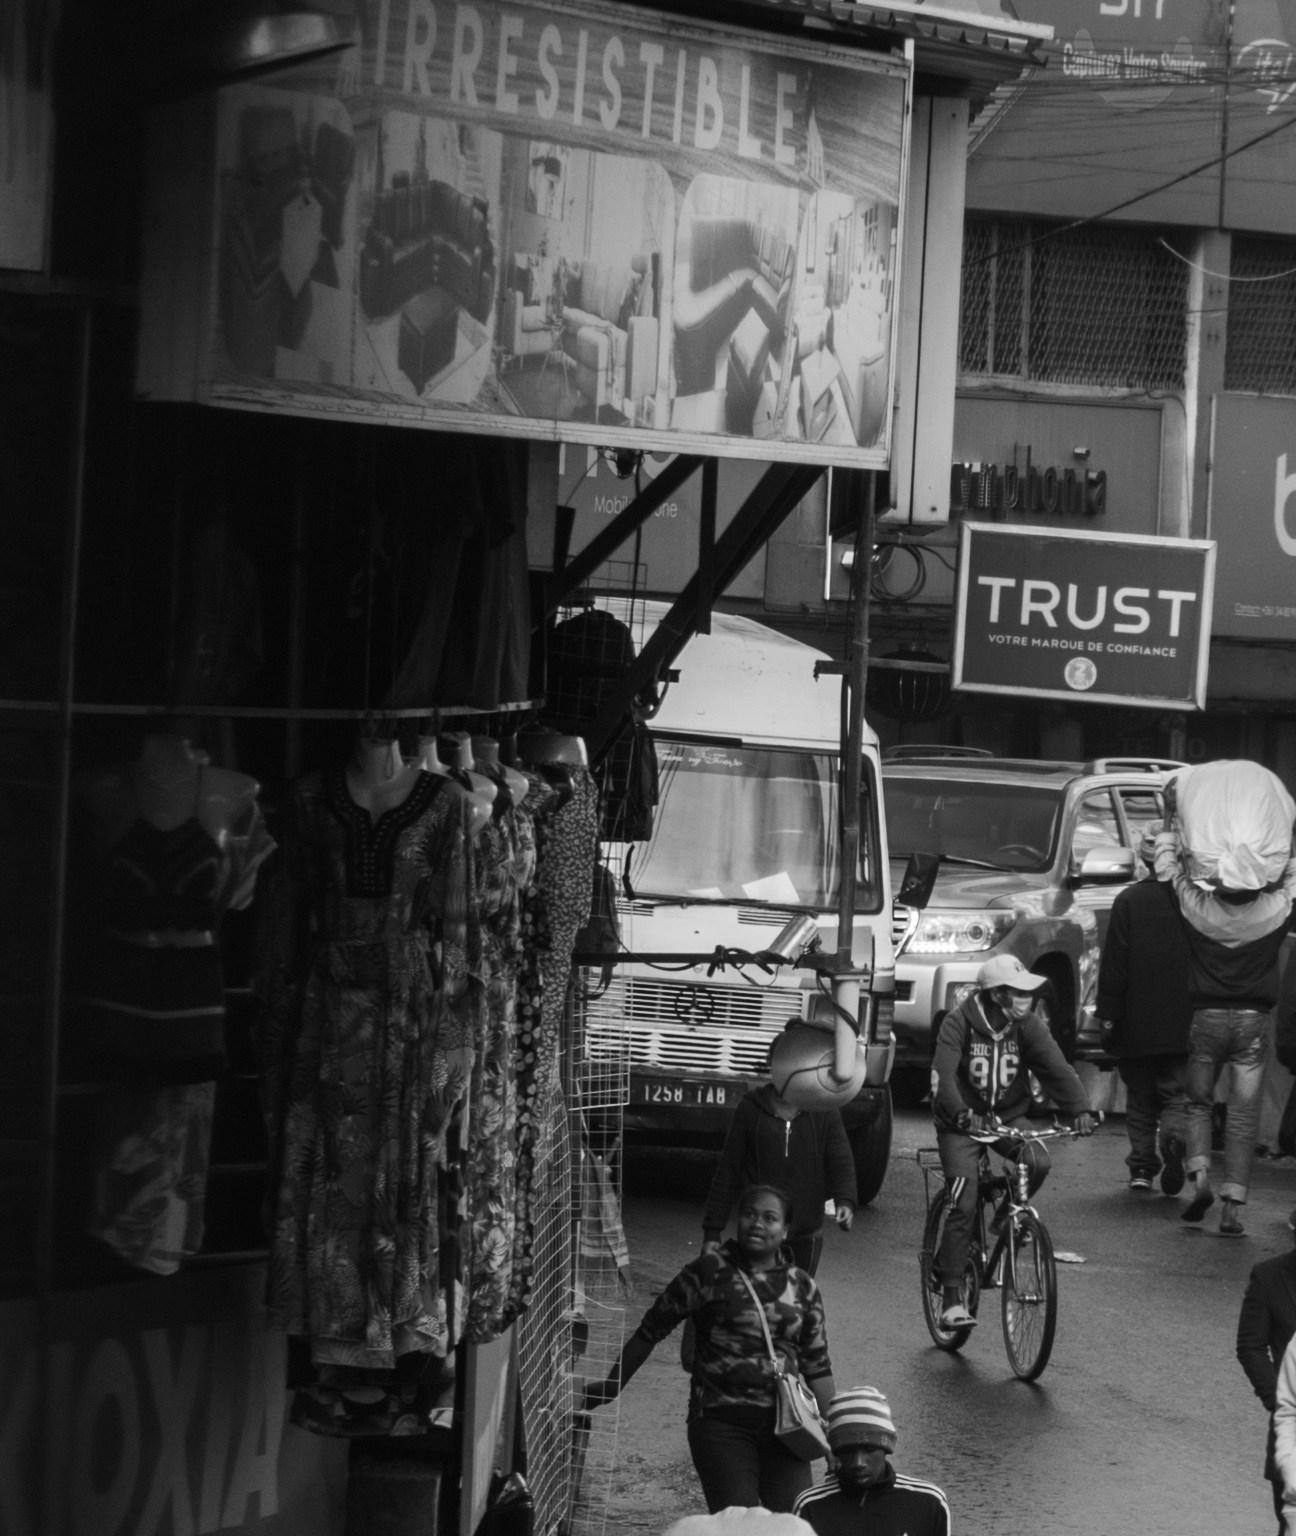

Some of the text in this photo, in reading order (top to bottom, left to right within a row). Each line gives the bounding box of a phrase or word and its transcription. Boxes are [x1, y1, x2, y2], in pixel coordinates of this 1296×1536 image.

[1062, 42, 1122, 79] Capturez
[977, 576, 1197, 637] TRUST
[988, 634, 1178, 659] VOTRE MARQUE DE CONFIANCE
[969, 1054, 1019, 1089] 96
